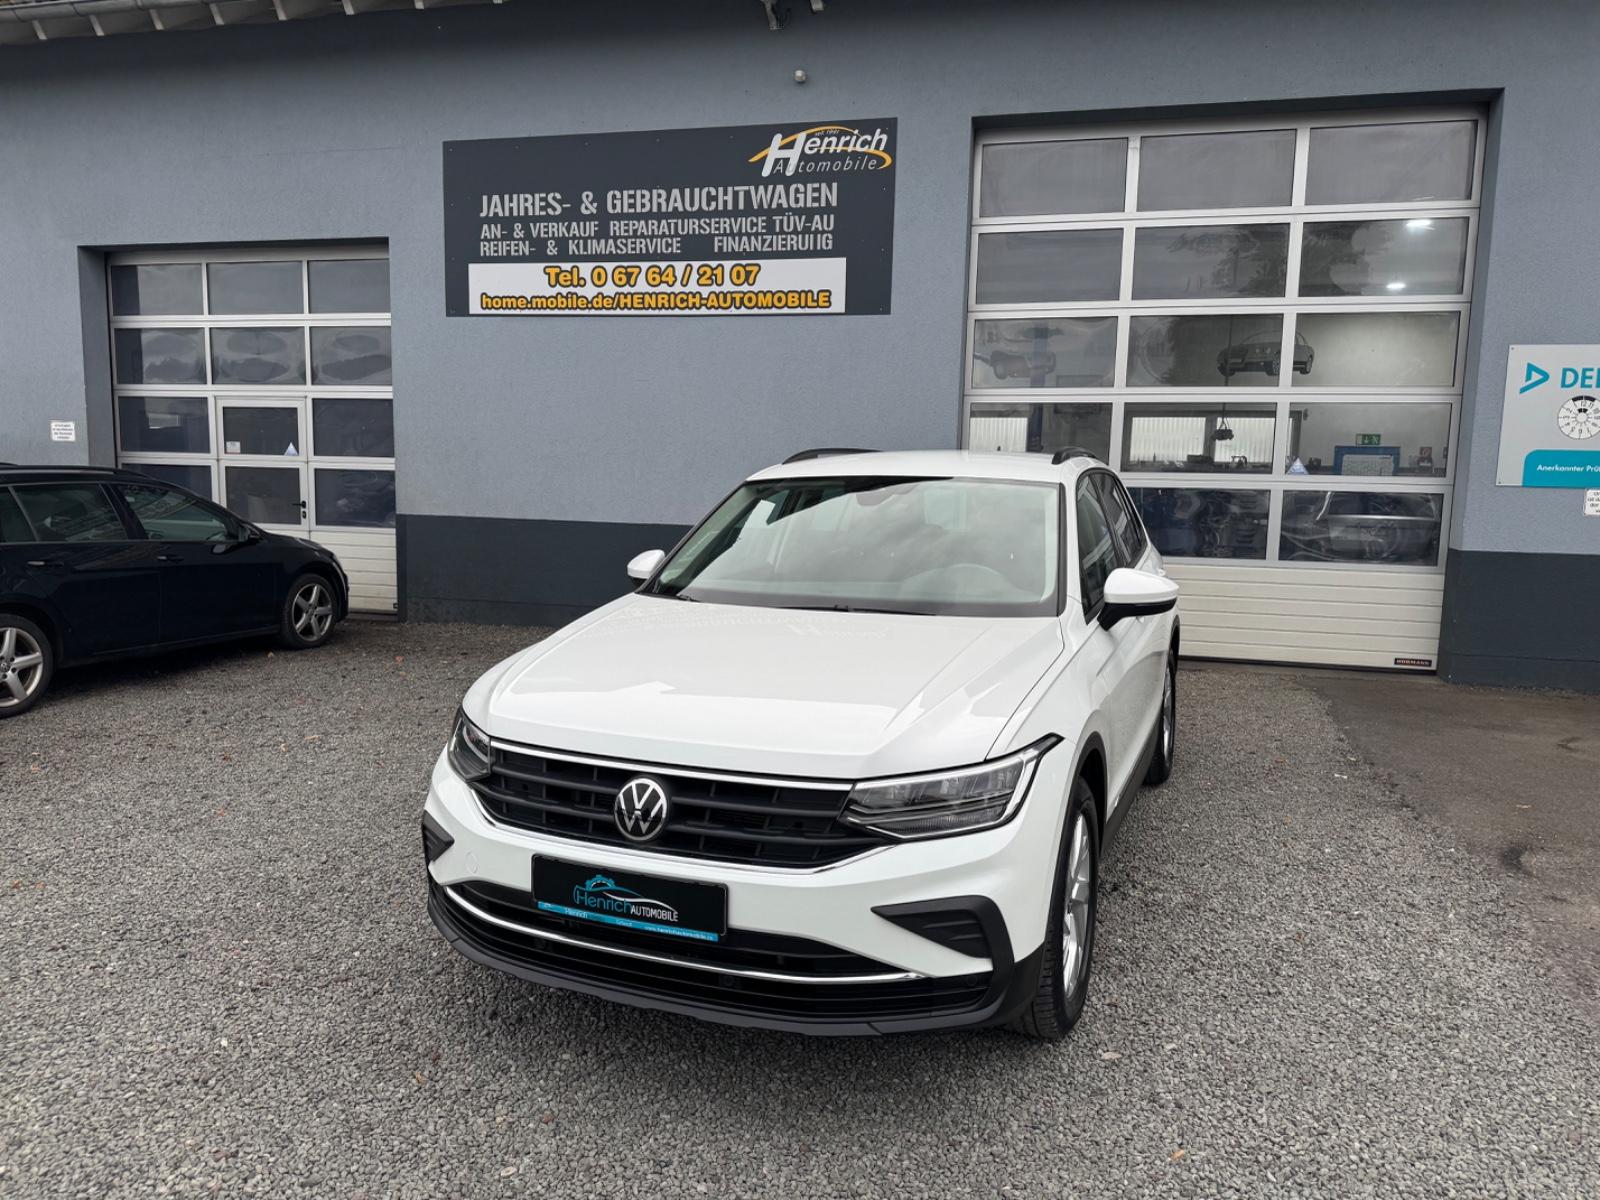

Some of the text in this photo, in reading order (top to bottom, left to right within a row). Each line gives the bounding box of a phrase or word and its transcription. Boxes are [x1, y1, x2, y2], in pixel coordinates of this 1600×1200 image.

[762, 128, 888, 177] Henrich
[773, 155, 877, 175] Atomobile
[480, 182, 838, 217] JAHRES- & GEBRAUCHTWAGEN
[480, 212, 835, 239] AN- & VERKAUF REPARATURSERVICE TÜV-AU
[480, 240, 536, 257] REIFEN-
[546, 239, 558, 255] &
[569, 237, 681, 255] KLIMASERVICE
[543, 263, 761, 288] Tel. 0 67 64 / 21 07
[480, 290, 832, 310] home.mobile.de/HENRICH-AUTOMOBILE
[1536, 464, 1584, 472] Anerkannter
[576, 887, 679, 923] Henrich AUTOMOBILE
